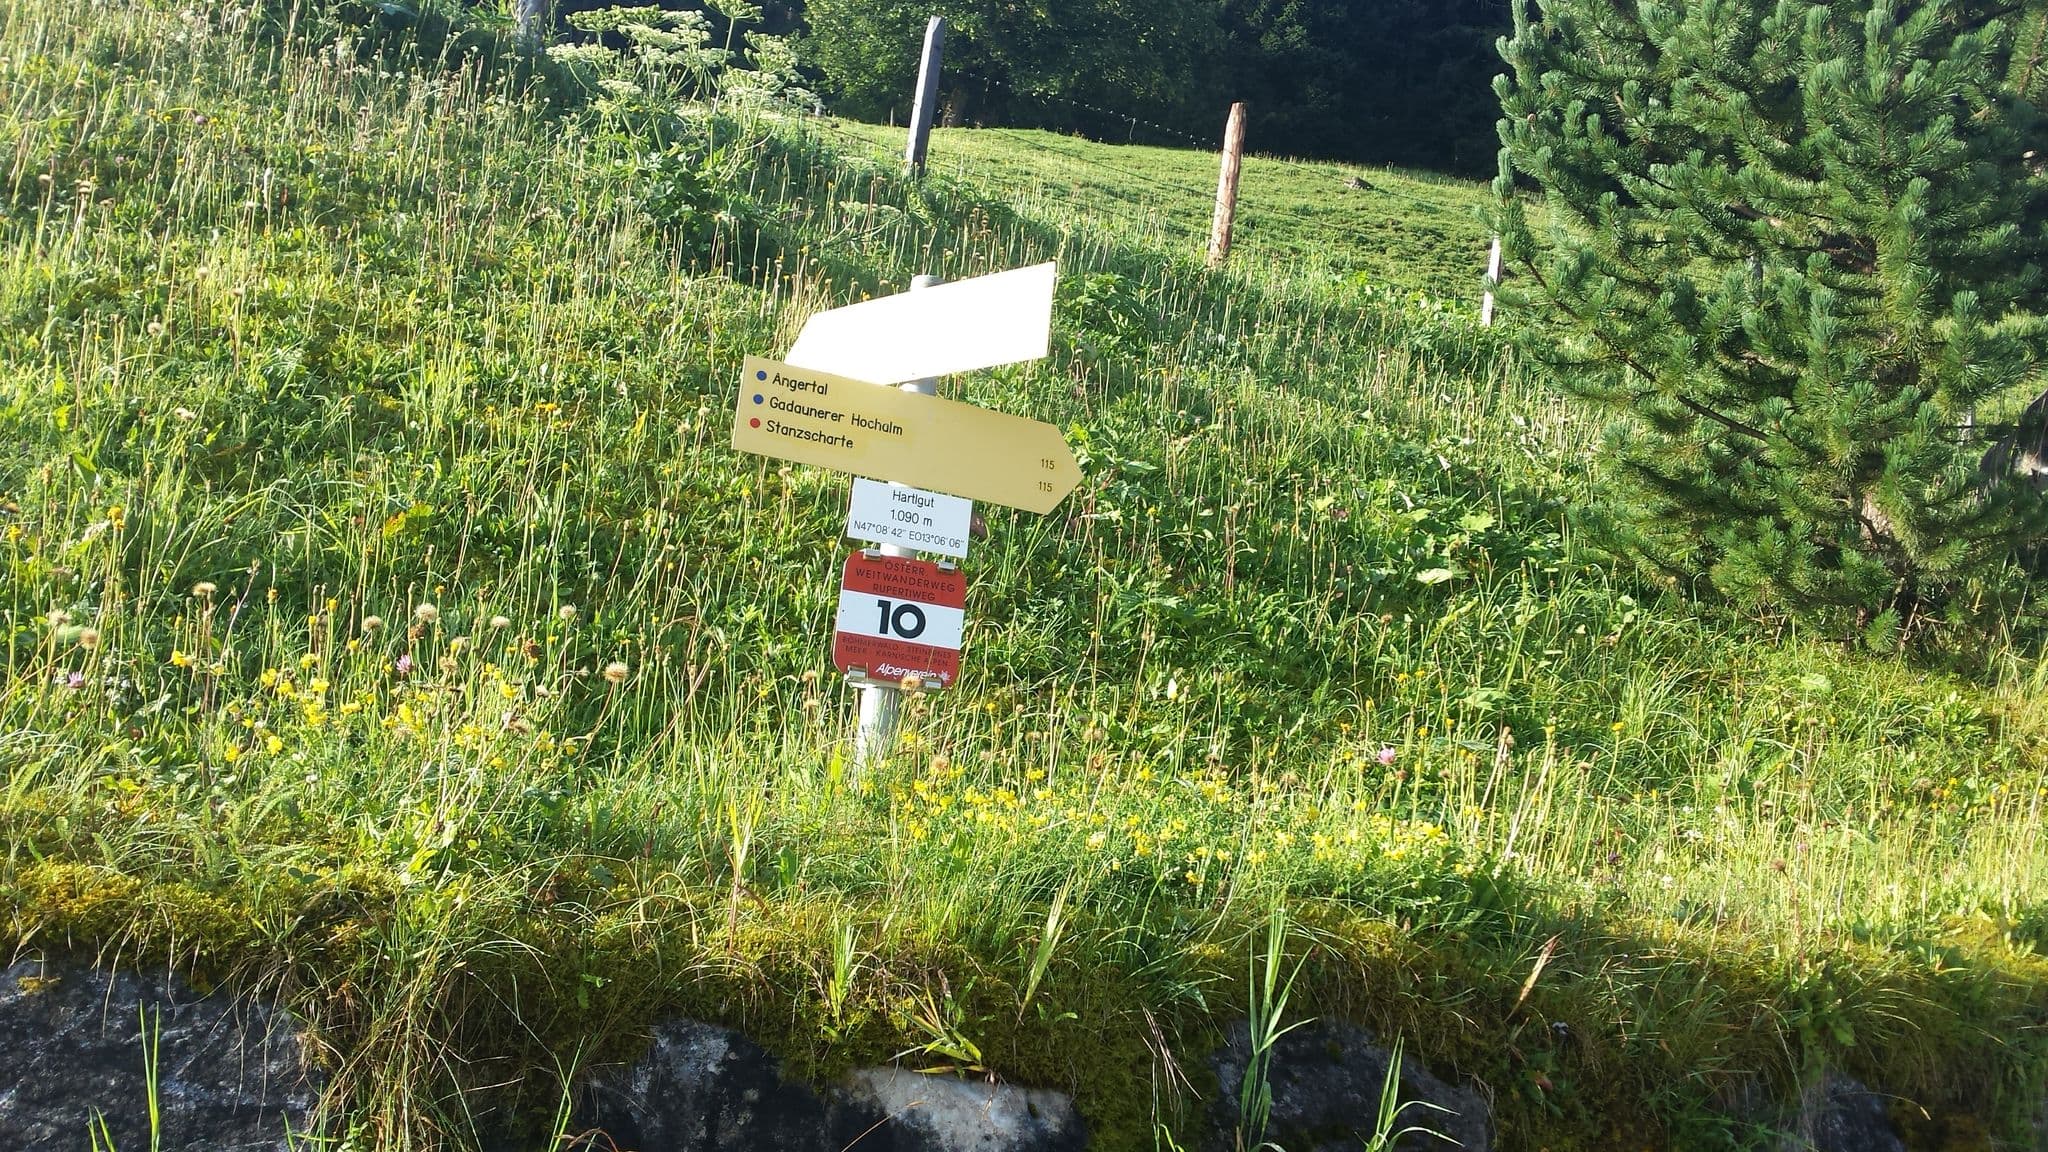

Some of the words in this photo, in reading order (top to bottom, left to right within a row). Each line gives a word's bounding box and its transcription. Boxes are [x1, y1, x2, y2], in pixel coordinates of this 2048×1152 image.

[772, 372, 828, 396] Angertal
[769, 396, 845, 423] Gadaunerer
[851, 413, 903, 436] Hochalm
[766, 420, 854, 449] Stanzscharte
[1041, 458, 1055, 470] 115
[1038, 481, 1053, 492] 115
[892, 490, 934, 508] Hartlgut
[890, 509, 919, 525] 1.090
[923, 516, 933, 527] m
[855, 567, 956, 593] WEITWANDERWEG
[872, 583, 936, 601] RUPERTIWEG
[877, 599, 926, 639] 10
[875, 663, 937, 679] Alpenverein
